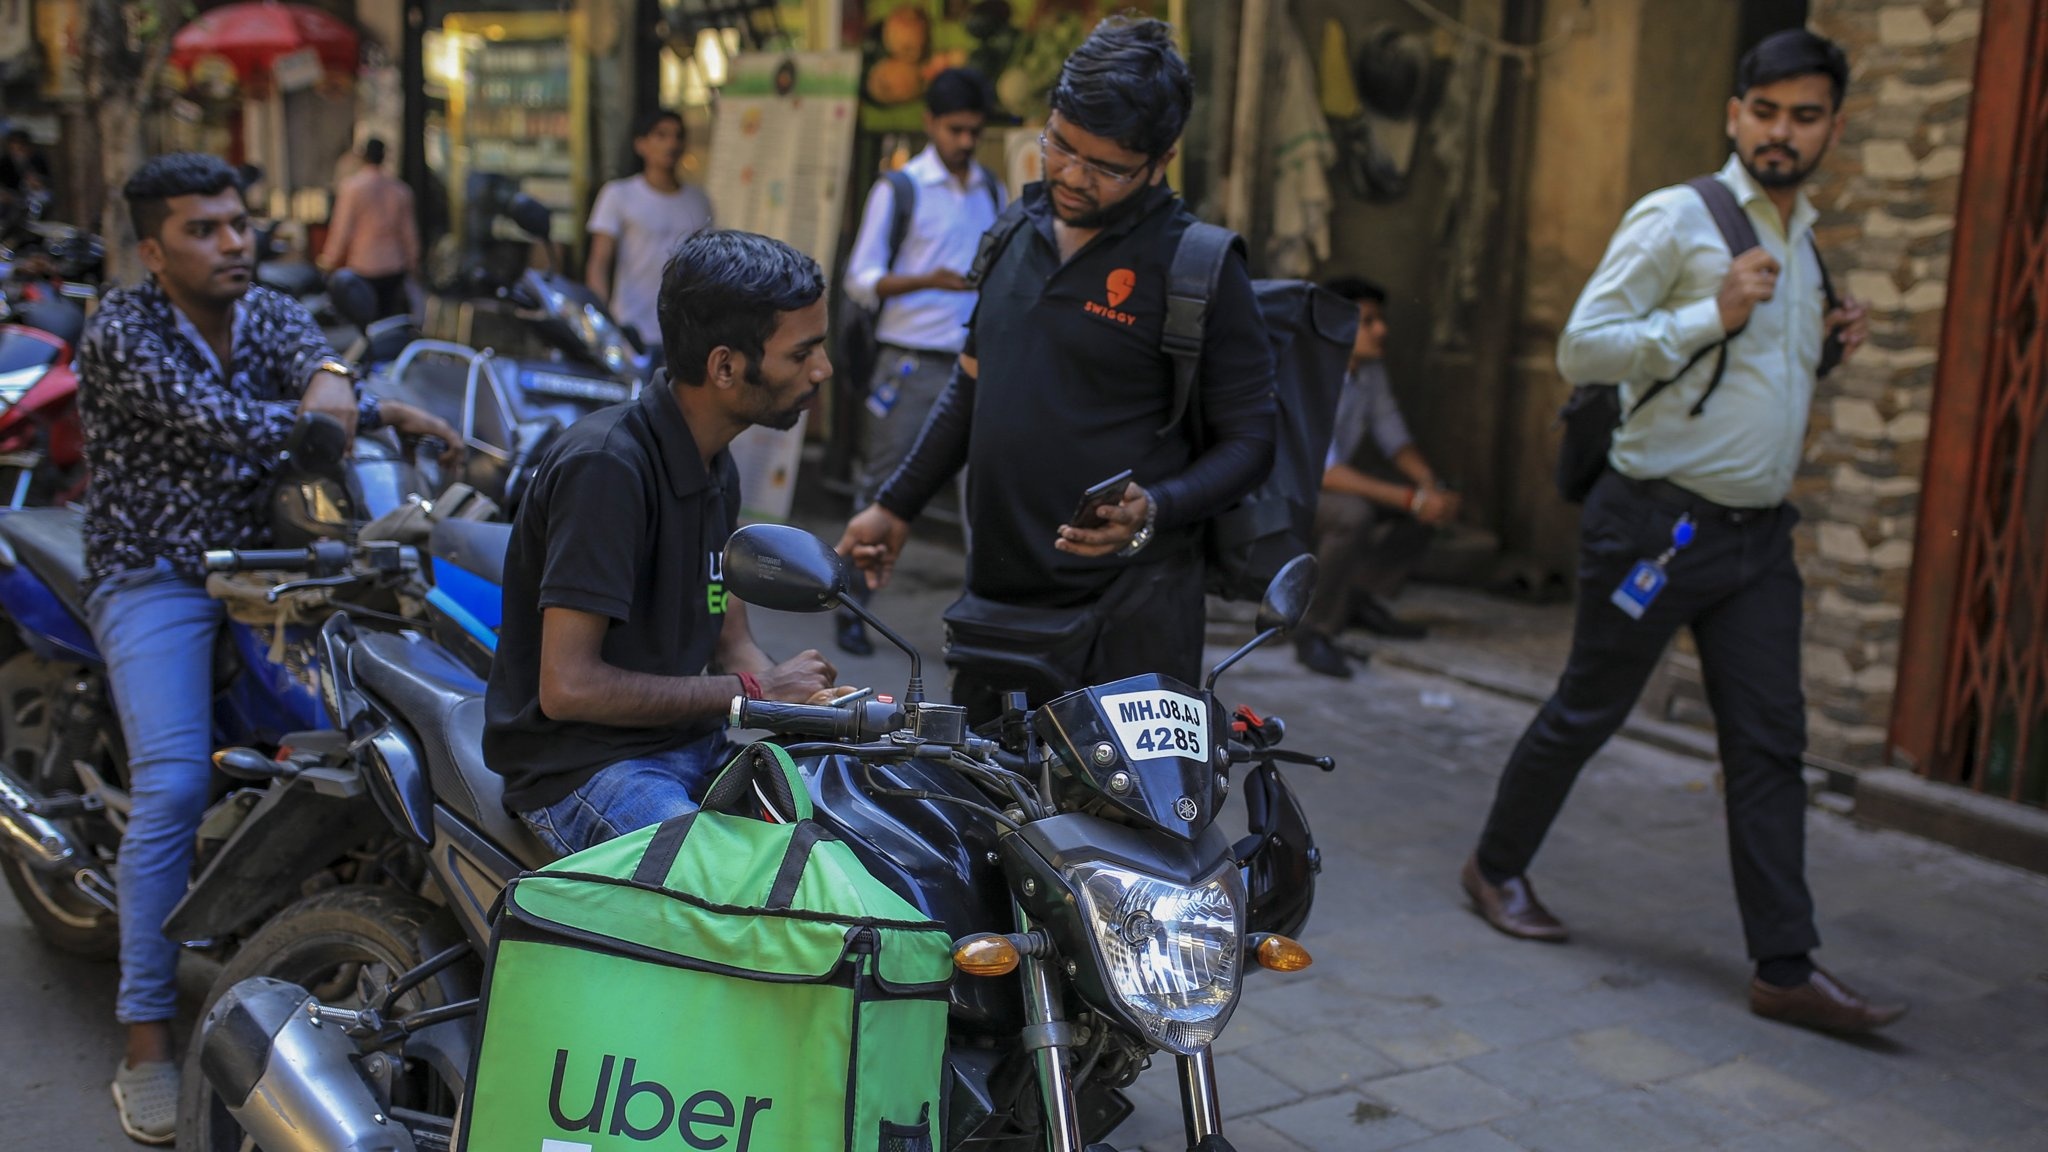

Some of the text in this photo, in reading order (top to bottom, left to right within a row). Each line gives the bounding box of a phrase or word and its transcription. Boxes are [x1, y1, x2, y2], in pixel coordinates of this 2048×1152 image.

[1084, 301, 1136, 325] SWIGGY
[1119, 699, 1200, 726] MH.08.AJ
[1136, 727, 1200, 754] 4285
[549, 1049, 772, 1152] Uber
